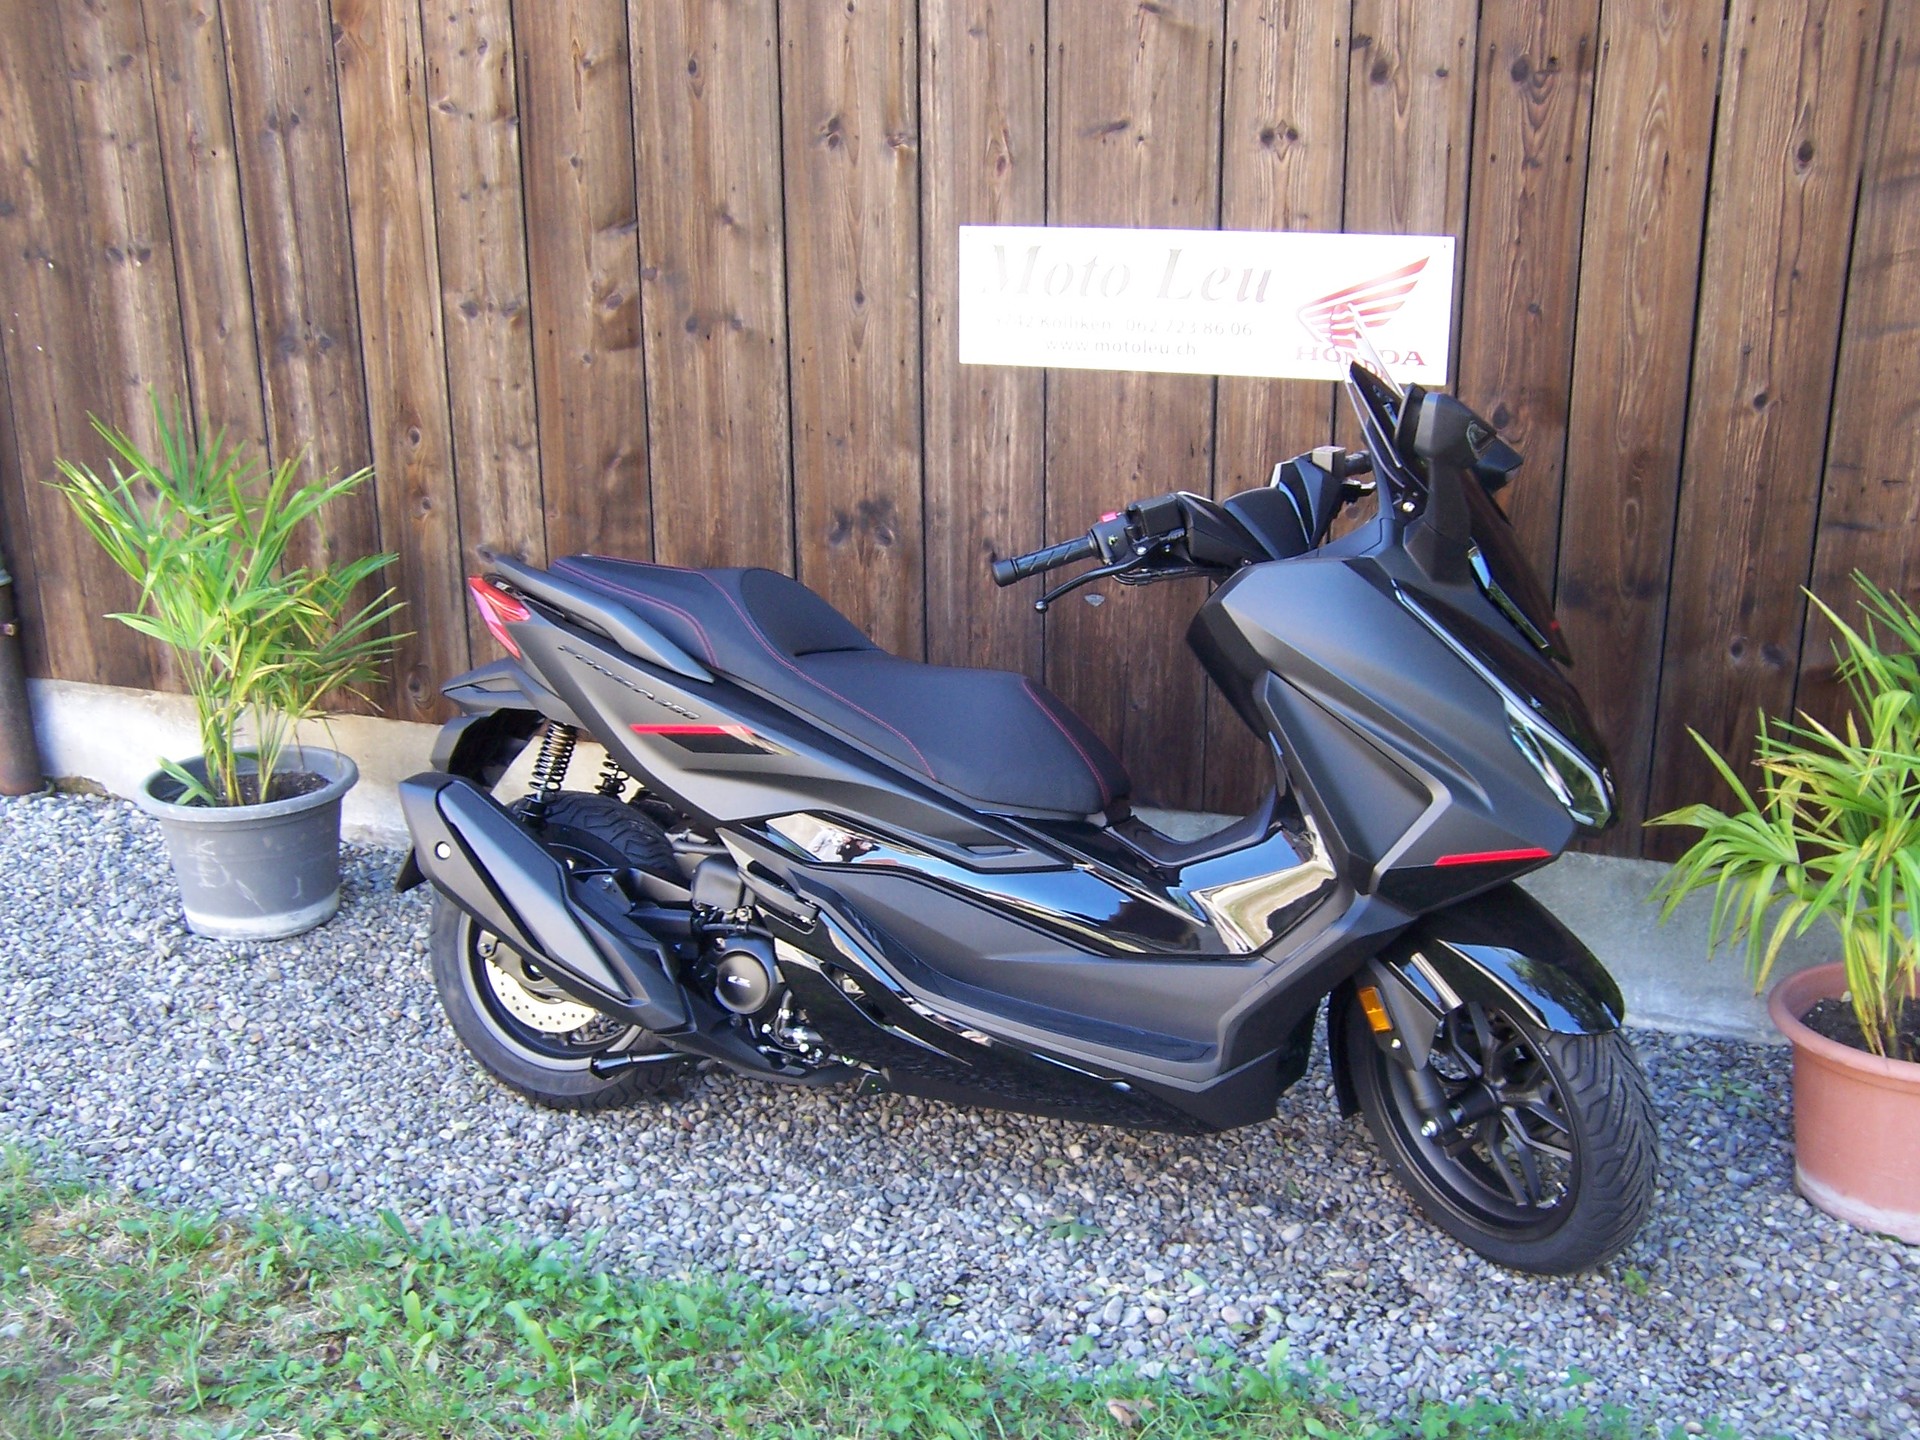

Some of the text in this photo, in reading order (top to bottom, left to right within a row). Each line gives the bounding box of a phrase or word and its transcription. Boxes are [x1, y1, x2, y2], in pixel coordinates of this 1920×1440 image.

[981, 244, 1273, 303] Moto Leu
[1126, 319, 1158, 334] 062
[1165, 319, 1196, 336] 723
[1203, 321, 1225, 336] 86
[1230, 321, 1253, 337] 06
[1045, 338, 1197, 356] www.motoleu.ch
